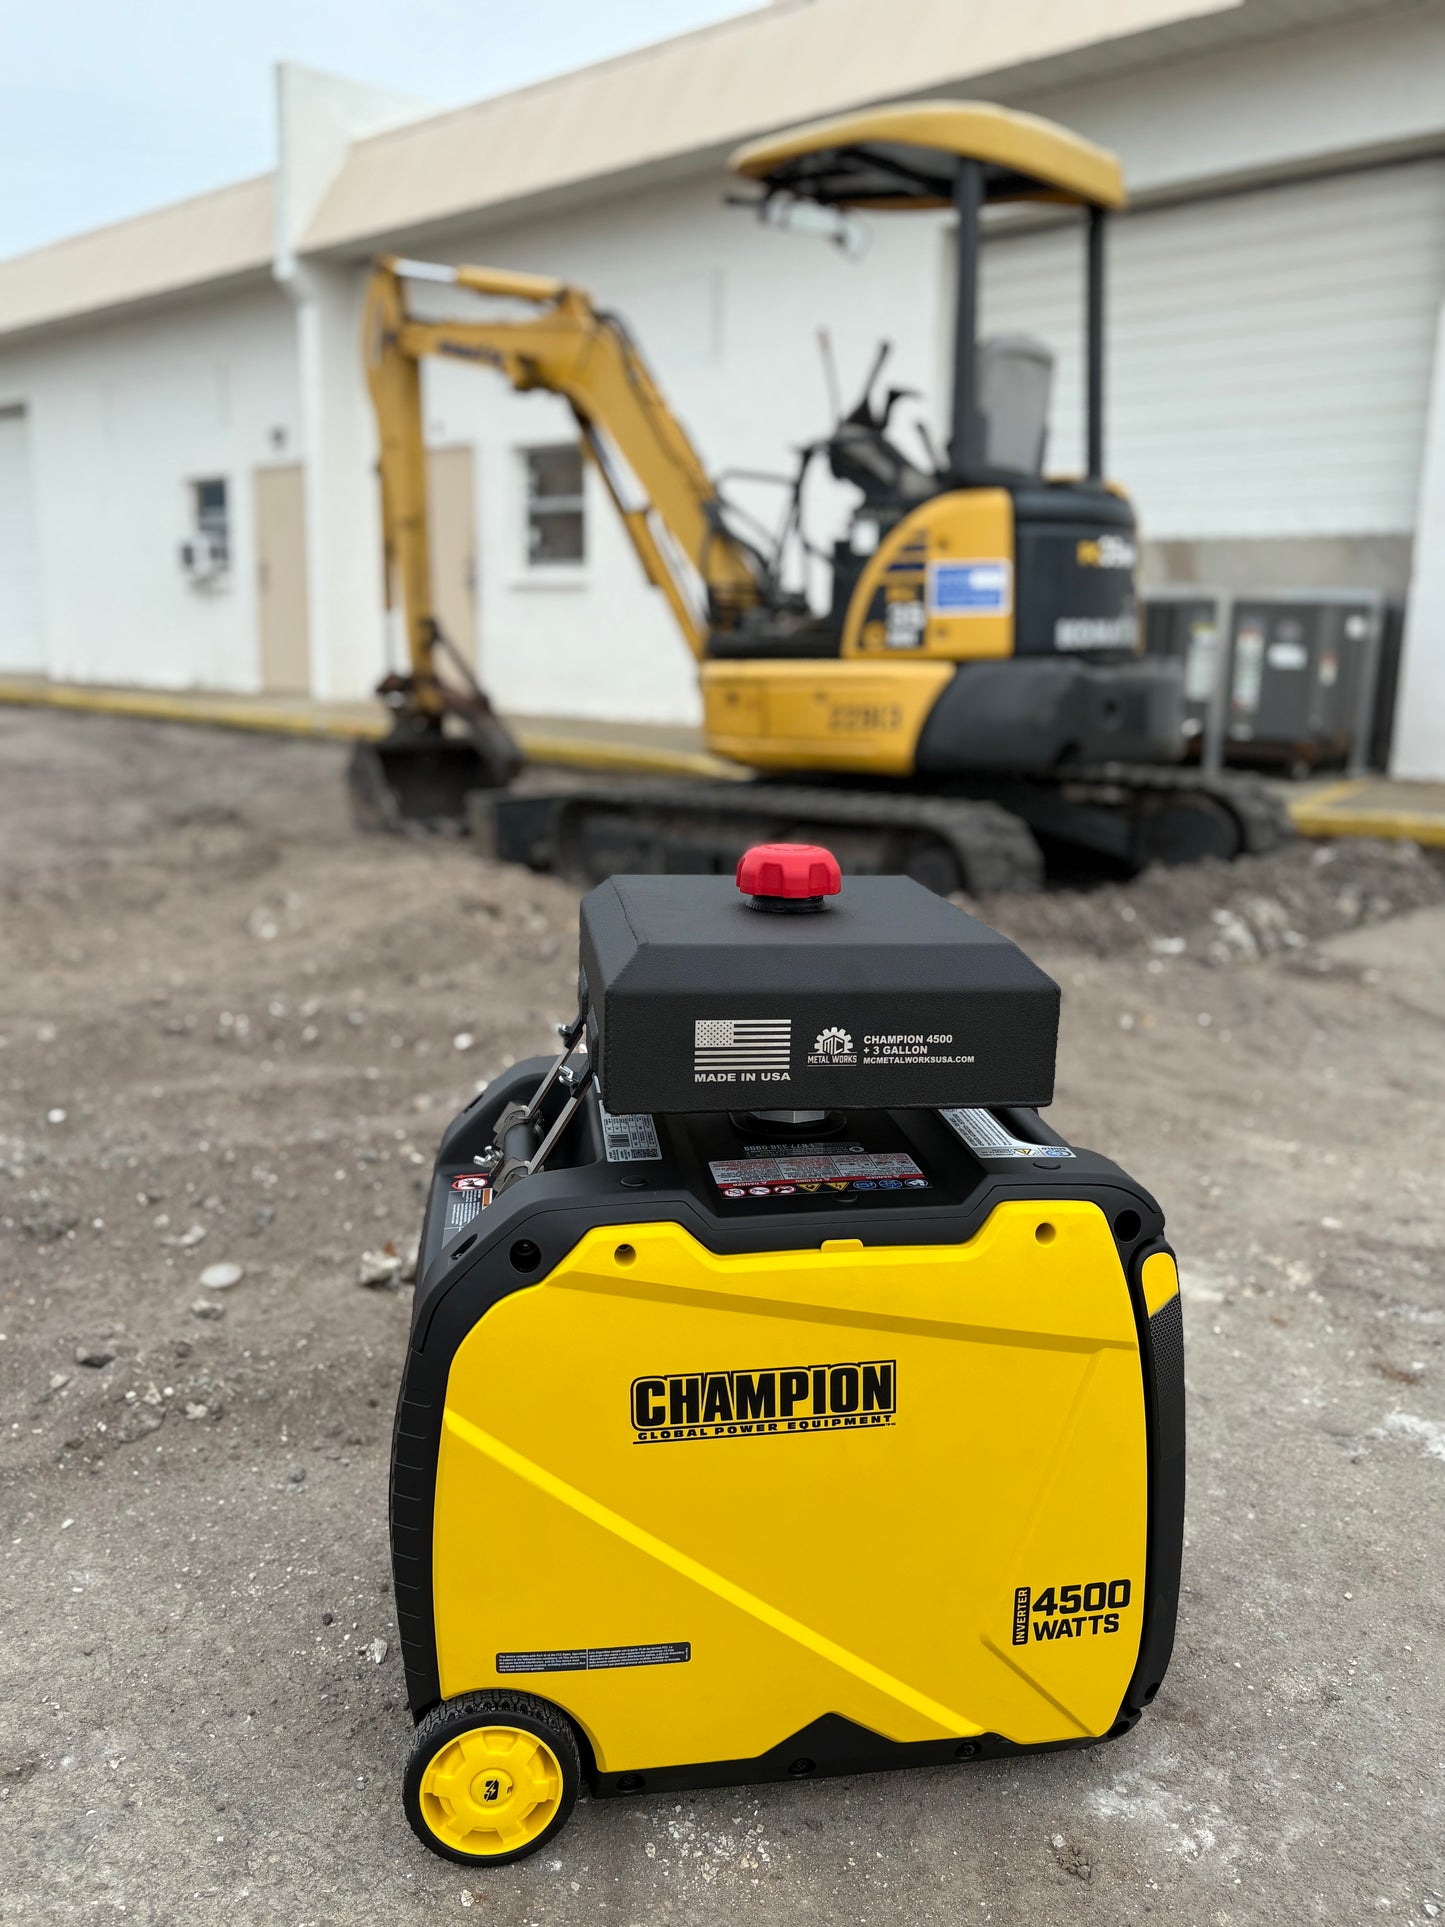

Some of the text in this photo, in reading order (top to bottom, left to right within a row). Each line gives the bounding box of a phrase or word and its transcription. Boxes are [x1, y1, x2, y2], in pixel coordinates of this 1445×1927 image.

[863, 1034, 953, 1045] CHAMPION 4500
[807, 1054, 857, 1064] METAL WORKS
[863, 1045, 928, 1055] + 3 GALLON
[863, 1055, 975, 1065] MCMETALWORKSUSA.COM
[694, 1072, 791, 1083] MADE IN USA
[632, 1361, 895, 1430] CHAMPION
[638, 1414, 892, 1441] GLOBAL POWER EQUIPMENT
[1032, 1579, 1131, 1616] 4500
[1015, 1589, 1028, 1643] INVERTER
[1033, 1613, 1119, 1641] WATTS
